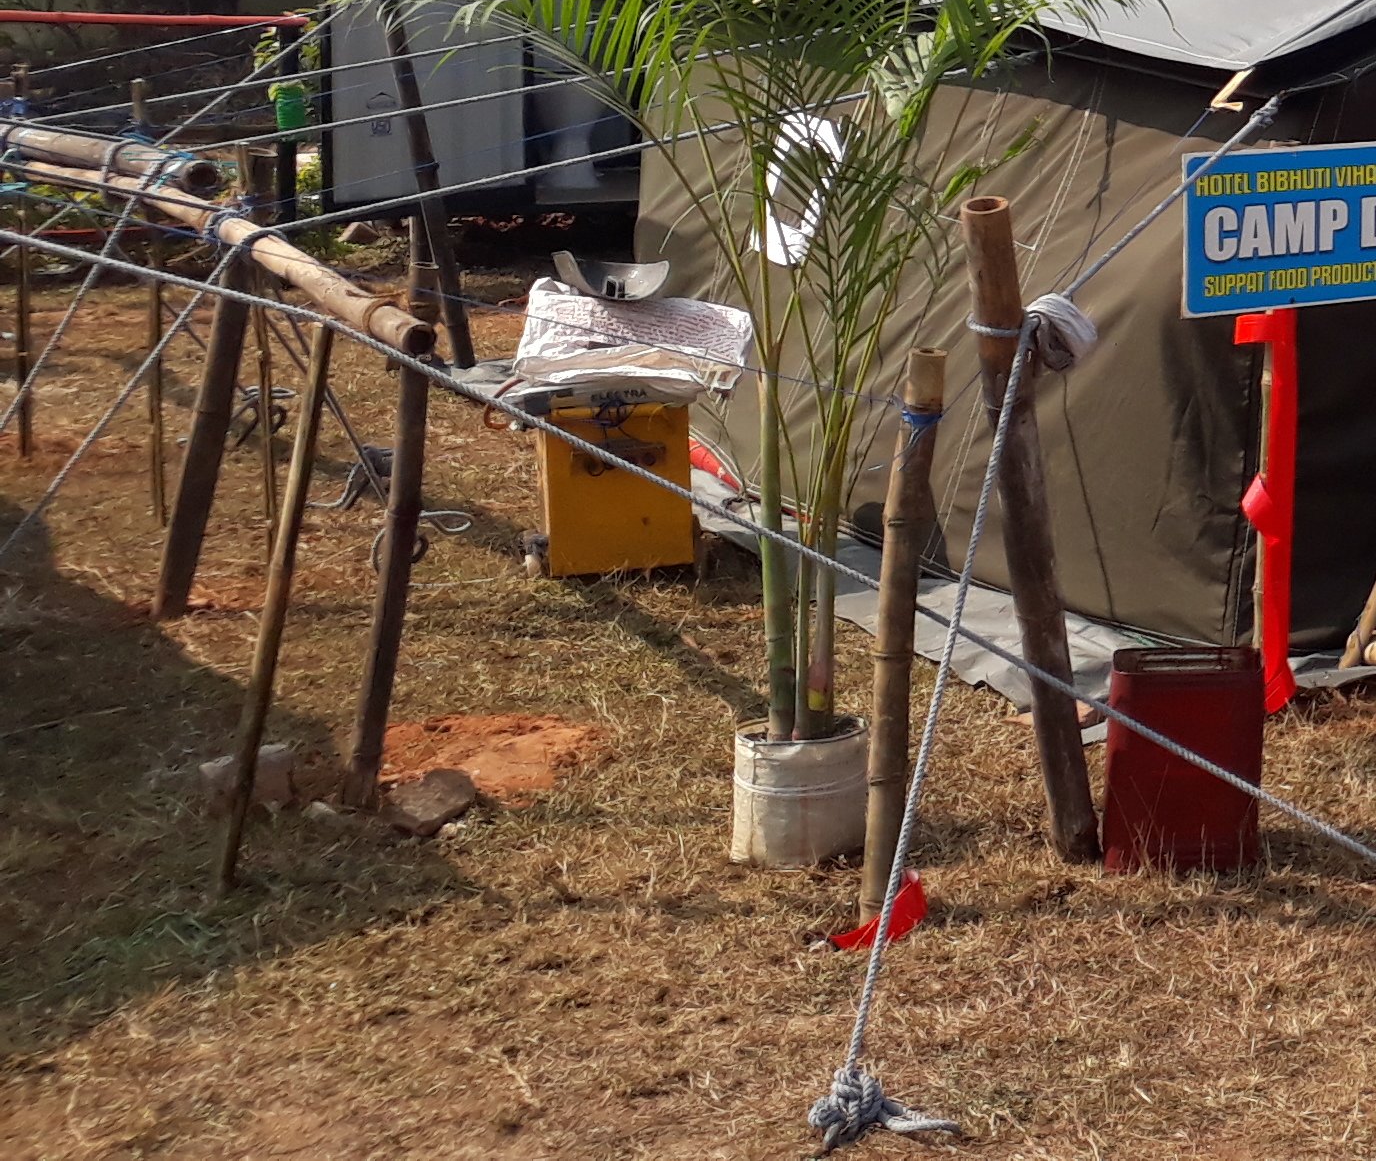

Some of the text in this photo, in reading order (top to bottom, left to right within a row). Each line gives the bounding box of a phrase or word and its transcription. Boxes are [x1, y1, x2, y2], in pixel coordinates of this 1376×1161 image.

[1196, 172, 1251, 197] HOTEL
[1256, 167, 1331, 193] BIBHUTI
[1204, 199, 1348, 262] CAMP
[1204, 271, 1265, 297] SUPPAT
[1268, 267, 1307, 291] FOOD
